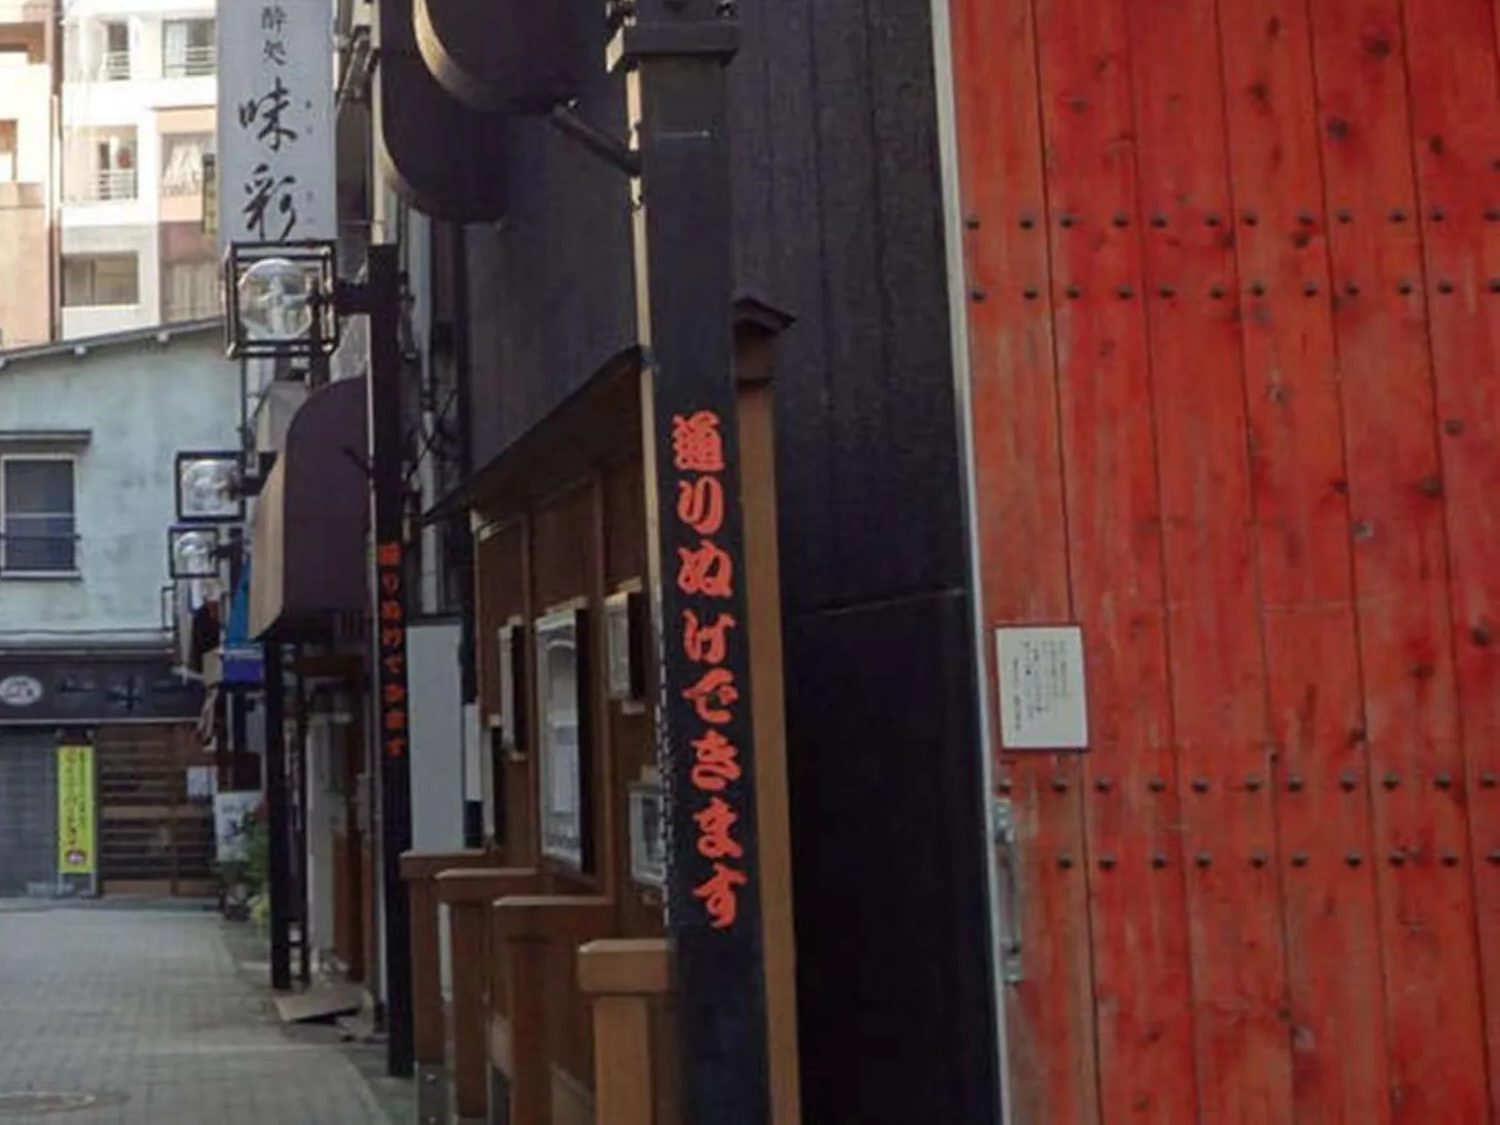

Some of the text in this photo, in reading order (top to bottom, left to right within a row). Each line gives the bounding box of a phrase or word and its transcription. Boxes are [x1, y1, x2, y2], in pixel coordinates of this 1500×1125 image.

[238, 76, 298, 241] 味彩
[672, 411, 747, 930] 通りぬけできます
